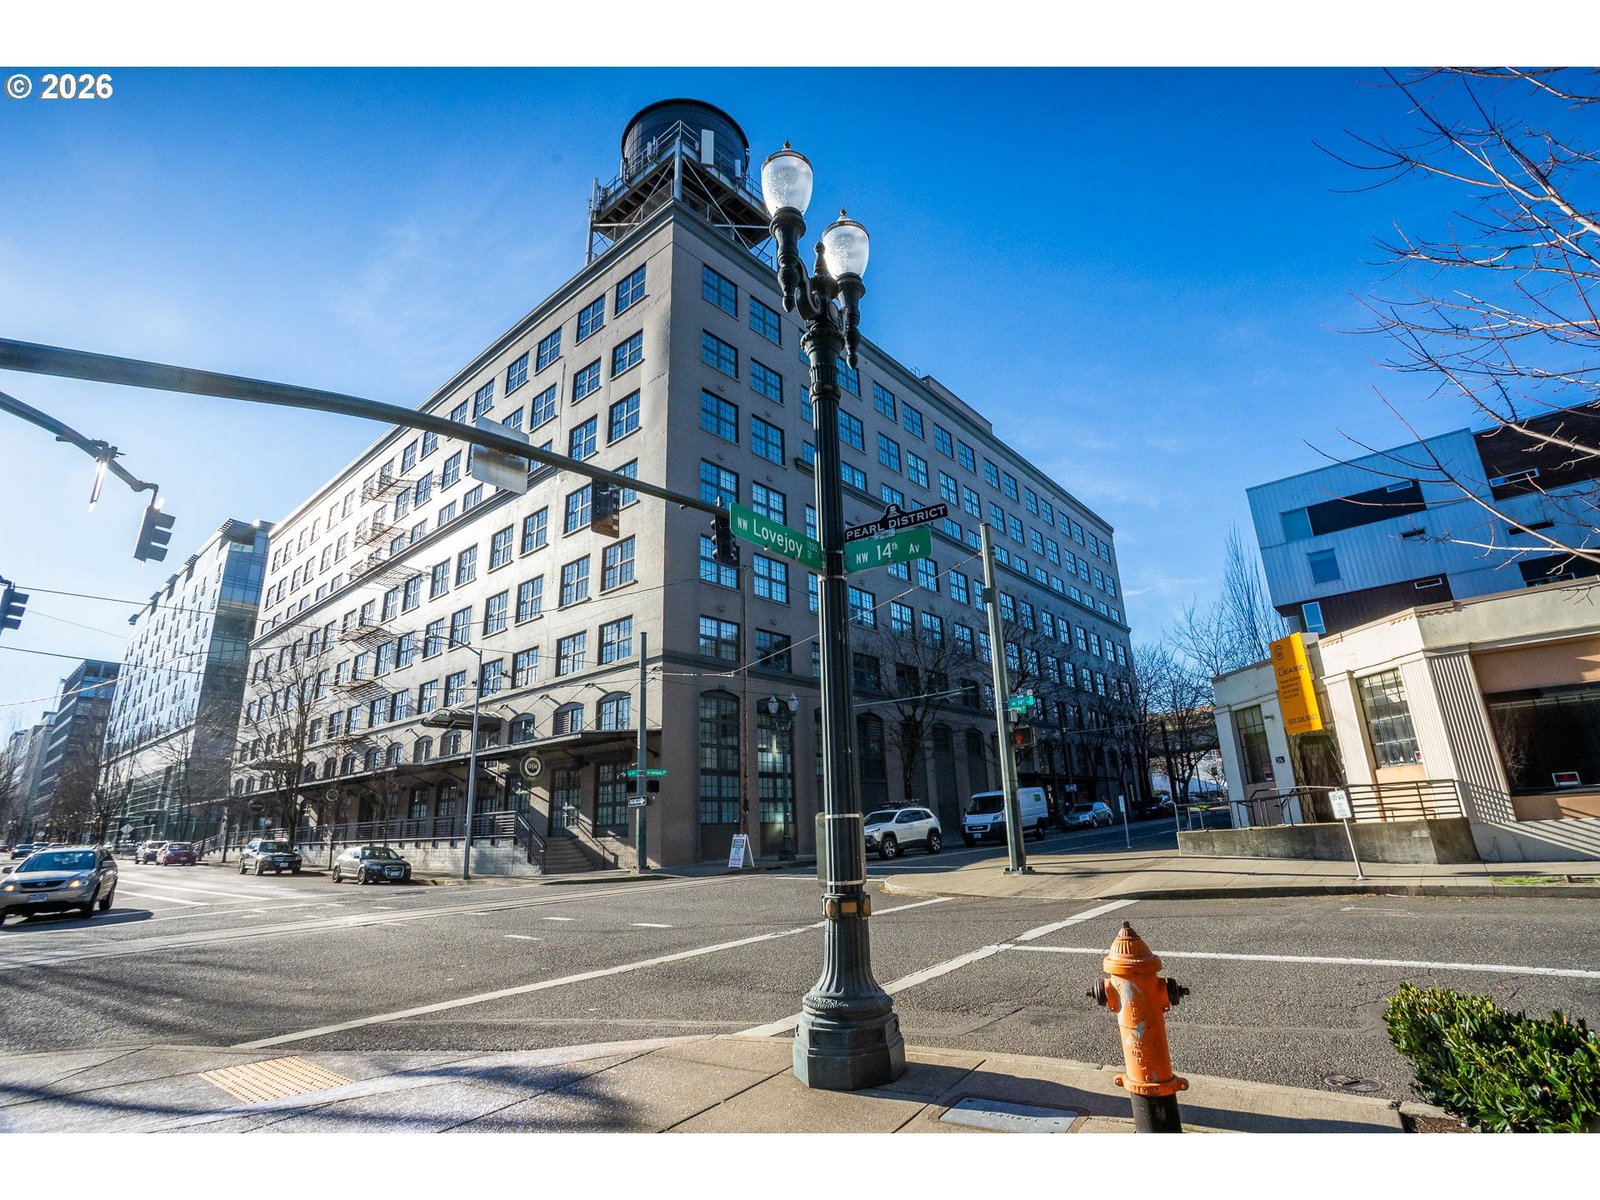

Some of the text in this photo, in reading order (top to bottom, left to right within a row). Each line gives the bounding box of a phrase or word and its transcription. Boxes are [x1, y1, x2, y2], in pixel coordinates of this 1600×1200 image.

[737, 516, 803, 558] NW Lovejoy
[846, 505, 945, 540] PEARL DISTRICT
[856, 541, 920, 565] NW 14th Av
[1278, 665, 1303, 677] LEASE
